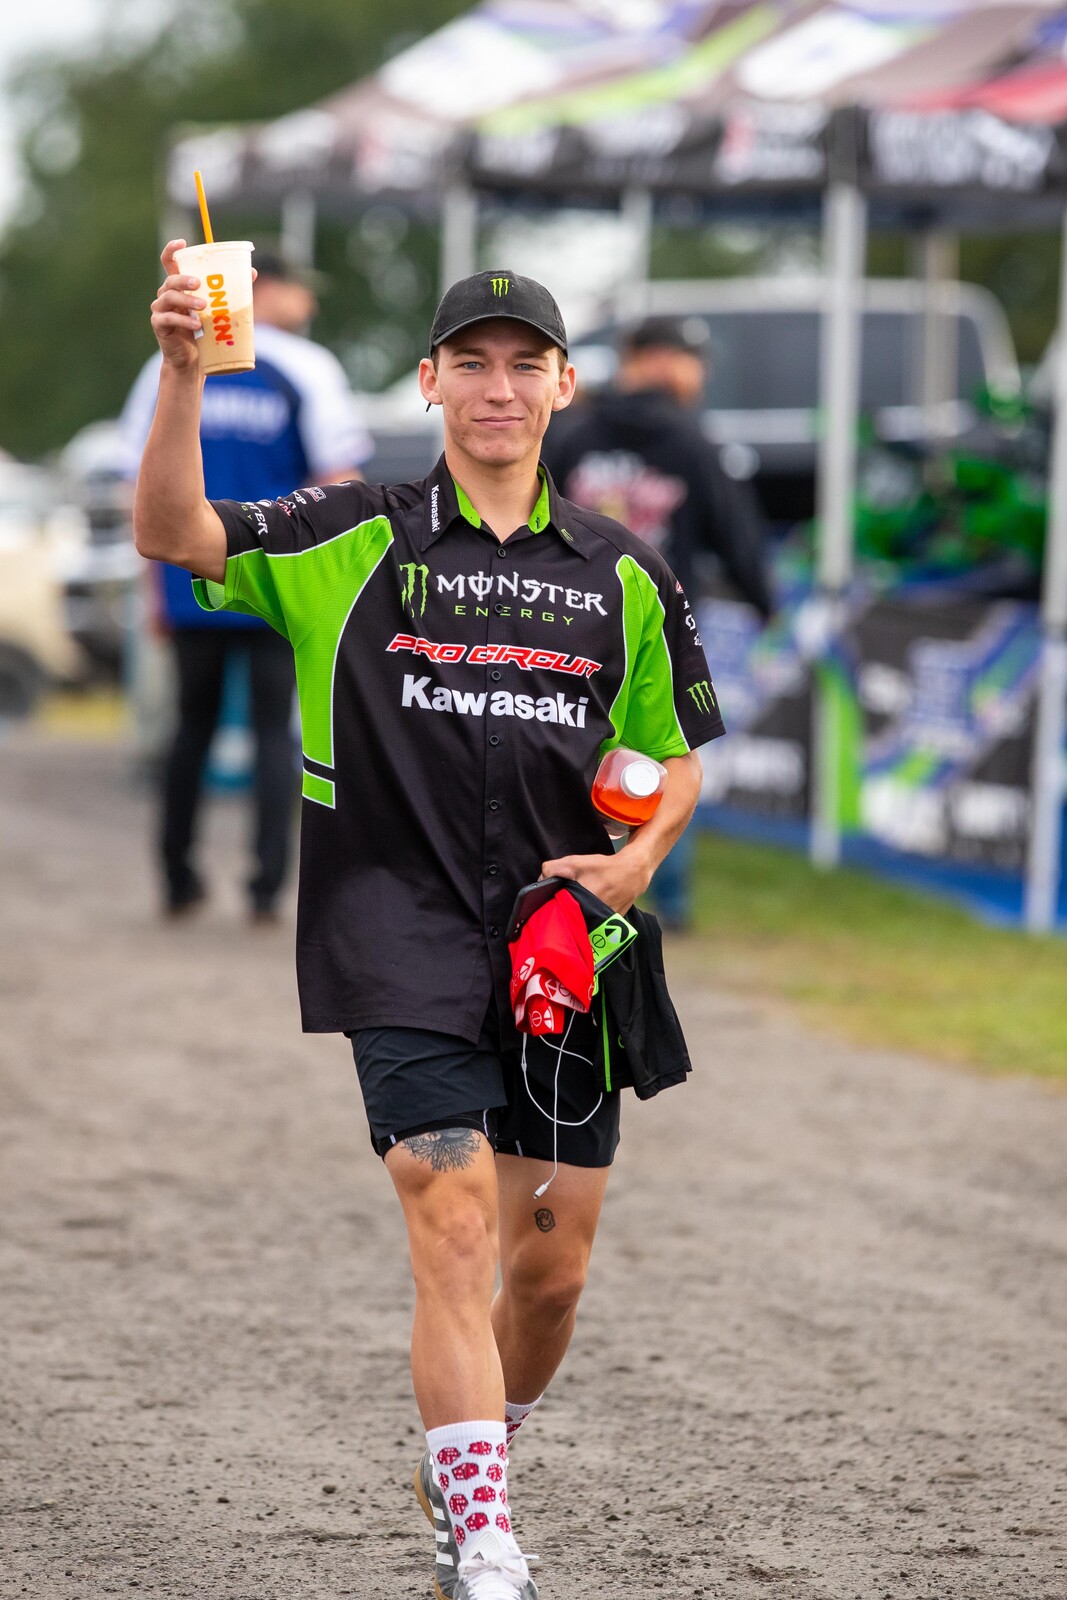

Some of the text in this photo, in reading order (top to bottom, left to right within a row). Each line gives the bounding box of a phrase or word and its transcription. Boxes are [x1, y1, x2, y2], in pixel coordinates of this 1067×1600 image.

[431, 484, 441, 533] Kawasaki
[436, 570, 608, 617] MONSTER
[455, 605, 574, 626] ENERGY
[385, 632, 603, 679] PRO CIRCUIT
[401, 673, 589, 729] Kawasaki
